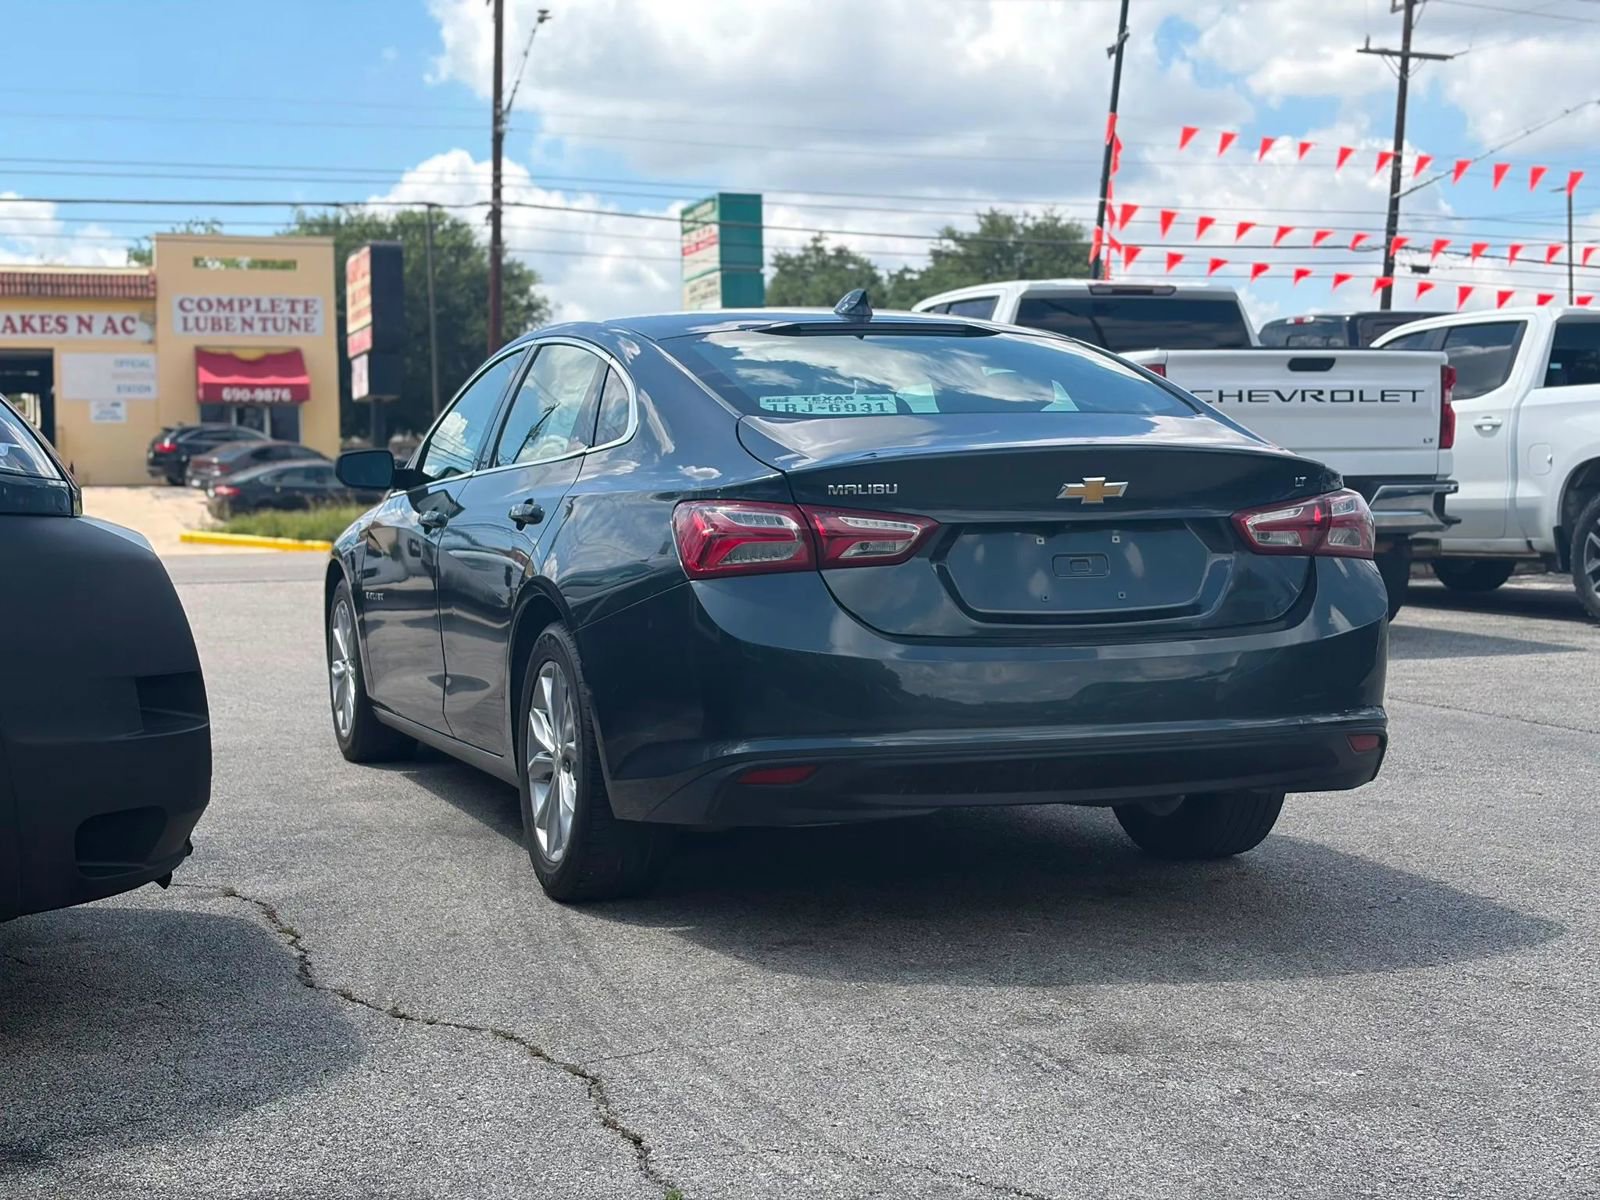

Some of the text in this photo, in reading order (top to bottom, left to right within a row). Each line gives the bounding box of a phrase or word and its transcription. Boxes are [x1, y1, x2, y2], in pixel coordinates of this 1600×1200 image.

[178, 297, 319, 314] COMPLETE
[76, 314, 94, 334] N
[102, 314, 137, 335] AC
[182, 315, 316, 334] LUBE N TUNE
[117, 384, 151, 394] STATION
[1190, 389, 1425, 403] CHEVROLET
[1294, 476, 1307, 487] LT
[827, 483, 898, 496] MALIBU
